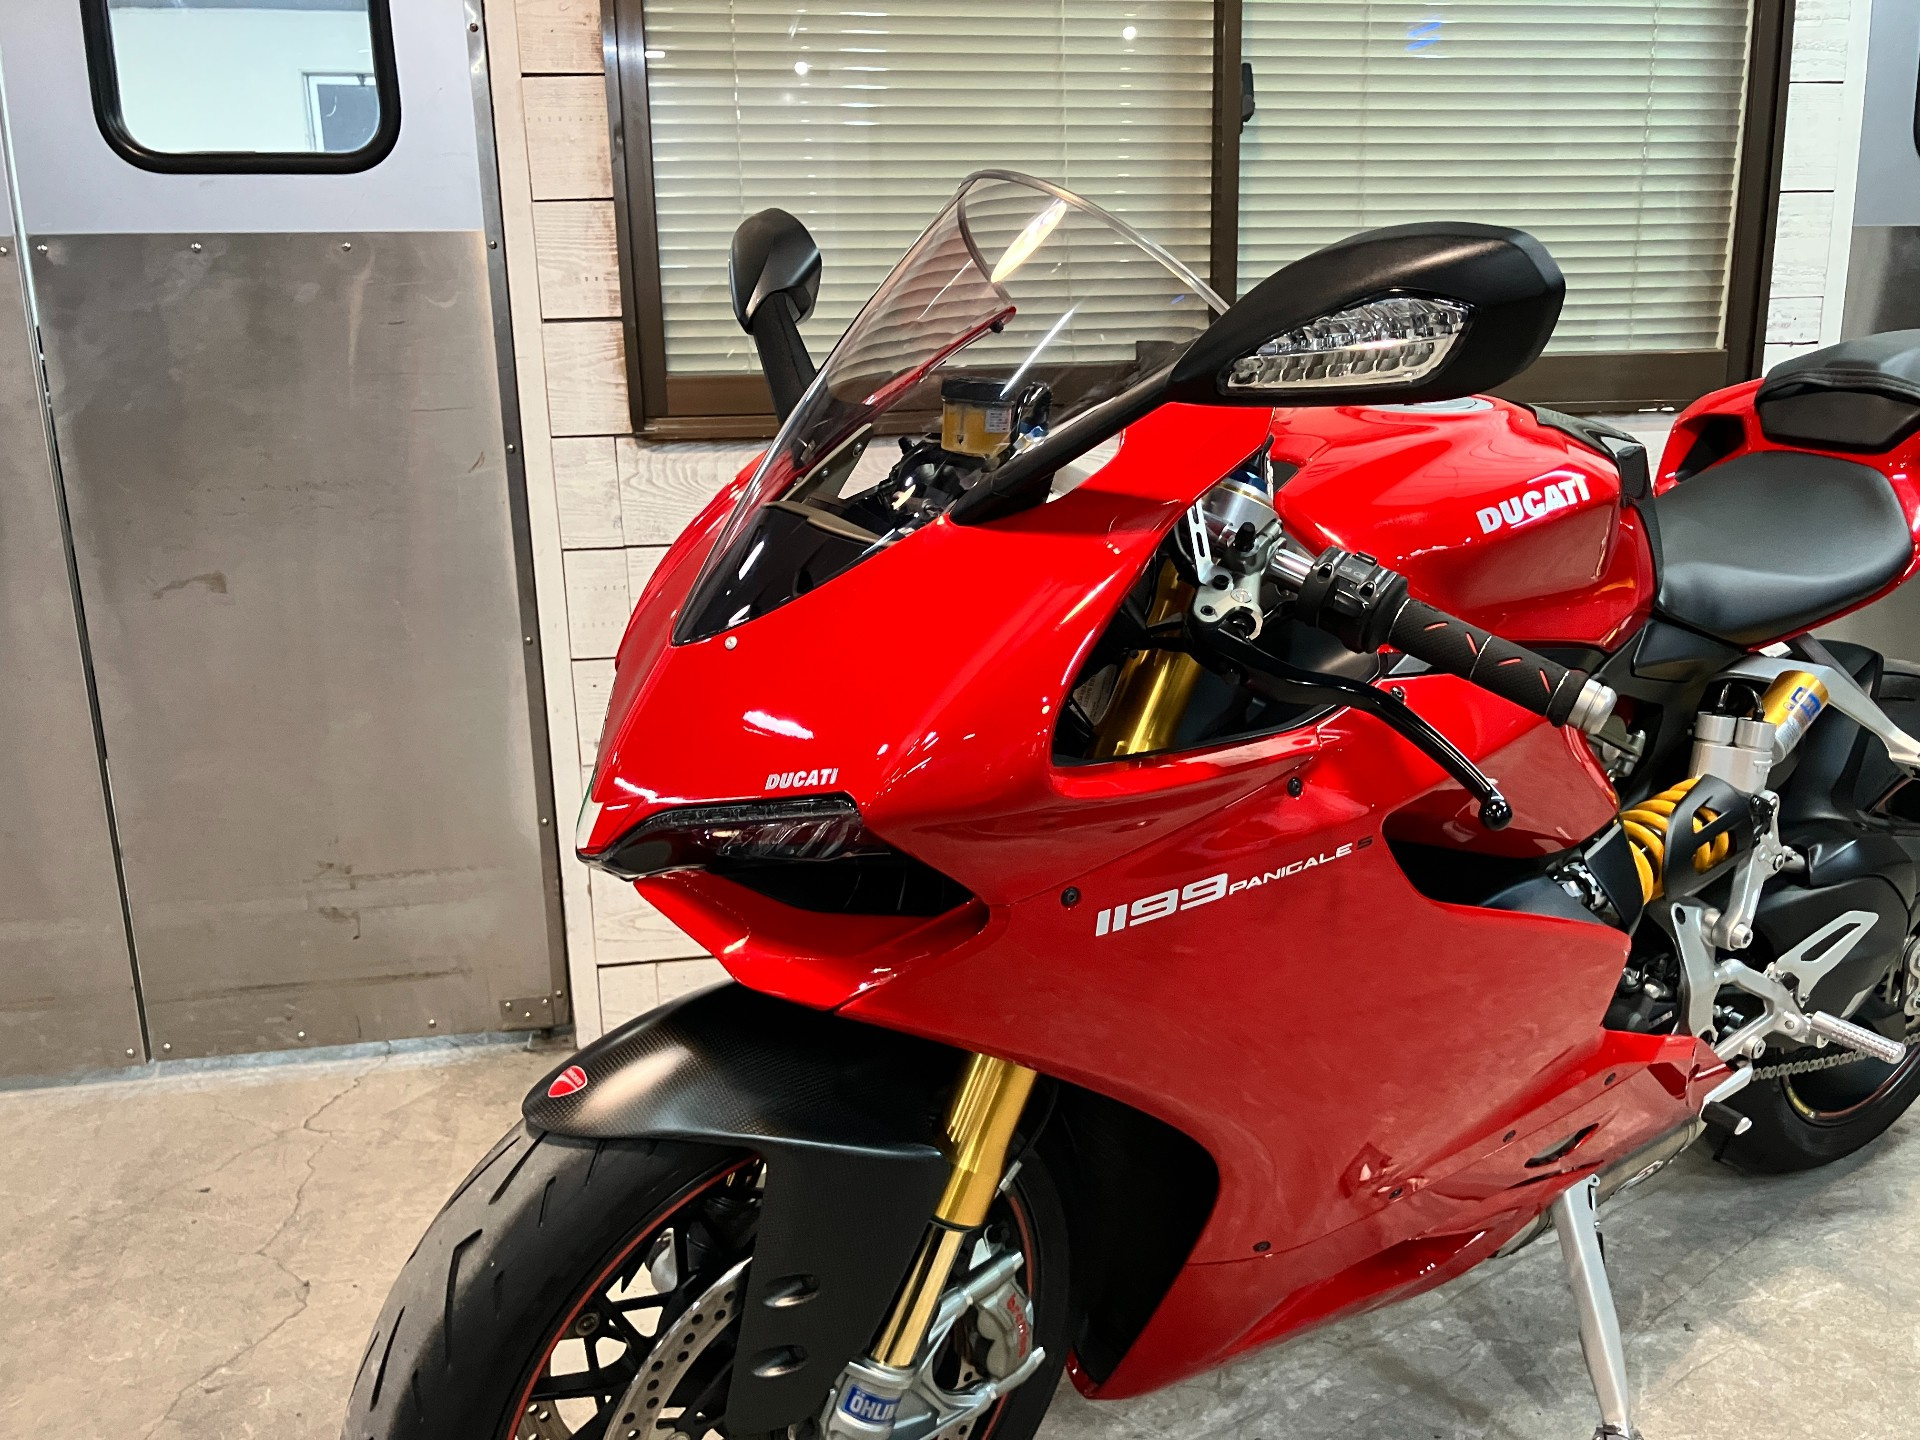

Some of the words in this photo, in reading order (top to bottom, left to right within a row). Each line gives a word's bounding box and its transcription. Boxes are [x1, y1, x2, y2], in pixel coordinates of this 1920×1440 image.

[1476, 476, 1590, 534] DUCATI
[764, 768, 839, 790] DUCATI
[1095, 873, 1228, 937] 1199
[1228, 843, 1353, 895] PANIGALE
[1356, 835, 1374, 850] S
